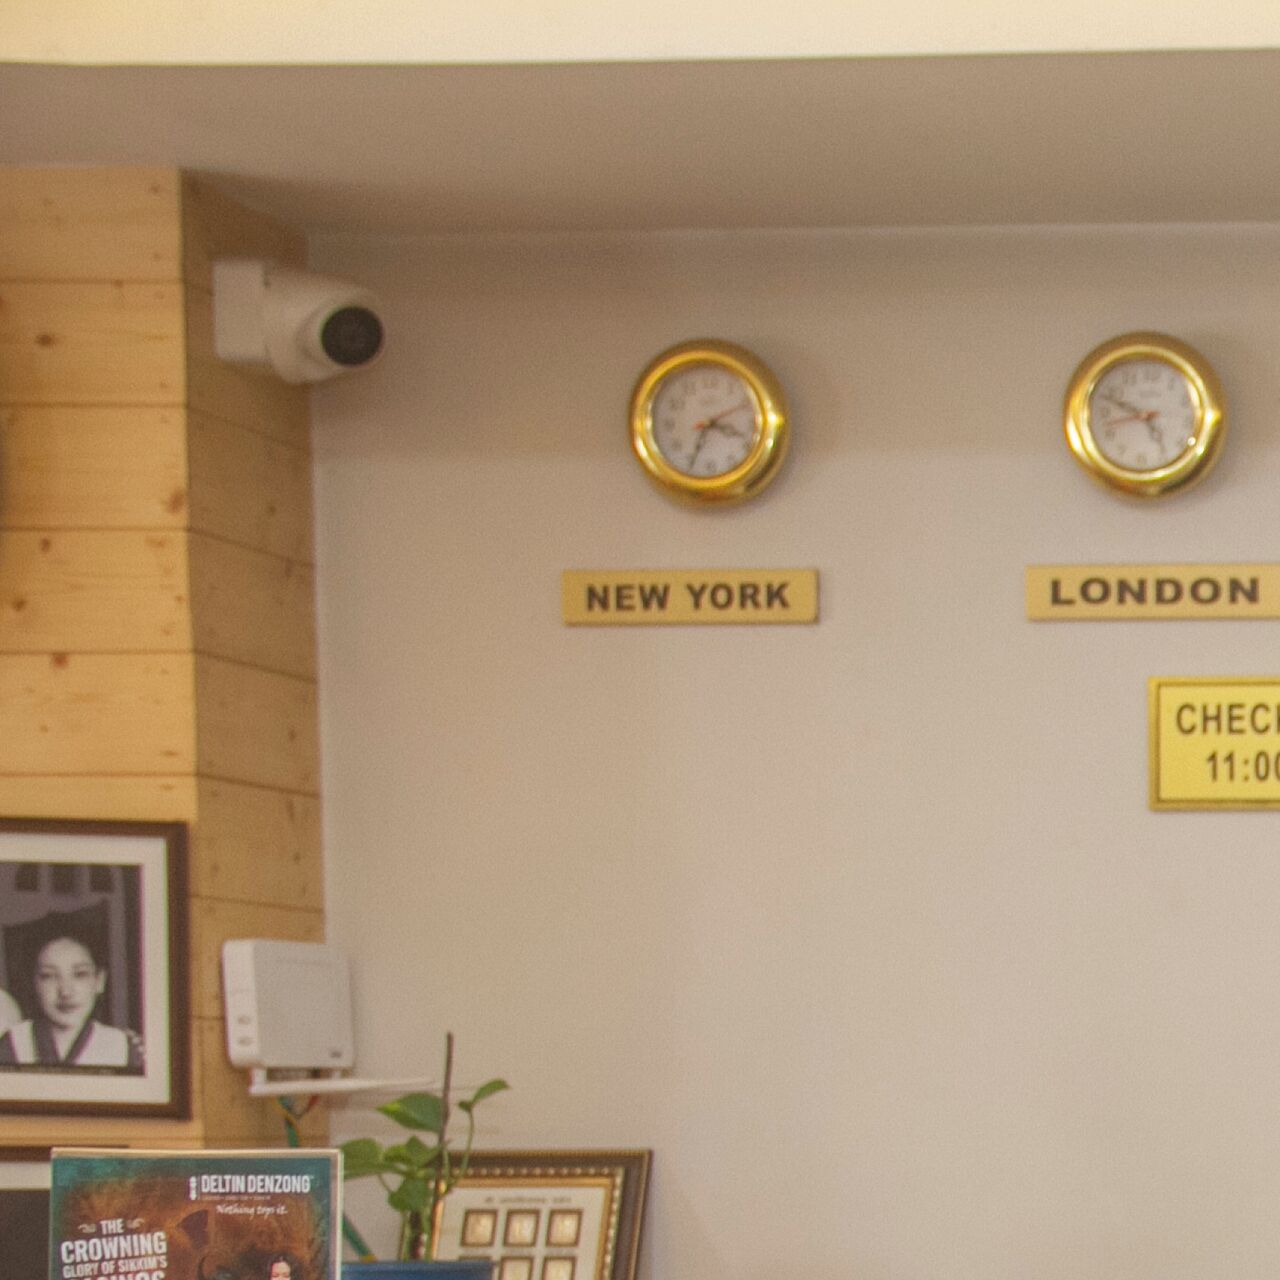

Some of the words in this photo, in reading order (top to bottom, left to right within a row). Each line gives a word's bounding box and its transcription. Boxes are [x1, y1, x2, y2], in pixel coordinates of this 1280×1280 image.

[585, 584, 670, 612] NEW
[685, 582, 791, 611] YORK
[1050, 576, 1260, 607] LONDON
[201, 1175, 246, 1193] DELTIN
[247, 1174, 311, 1194] DENZONG
[100, 1218, 124, 1235] THE
[61, 1231, 168, 1264] CROWNING
[62, 1262, 99, 1279] GLORY
[101, 1260, 116, 1275] OF
[118, 1255, 168, 1273] SIKKIM'S
